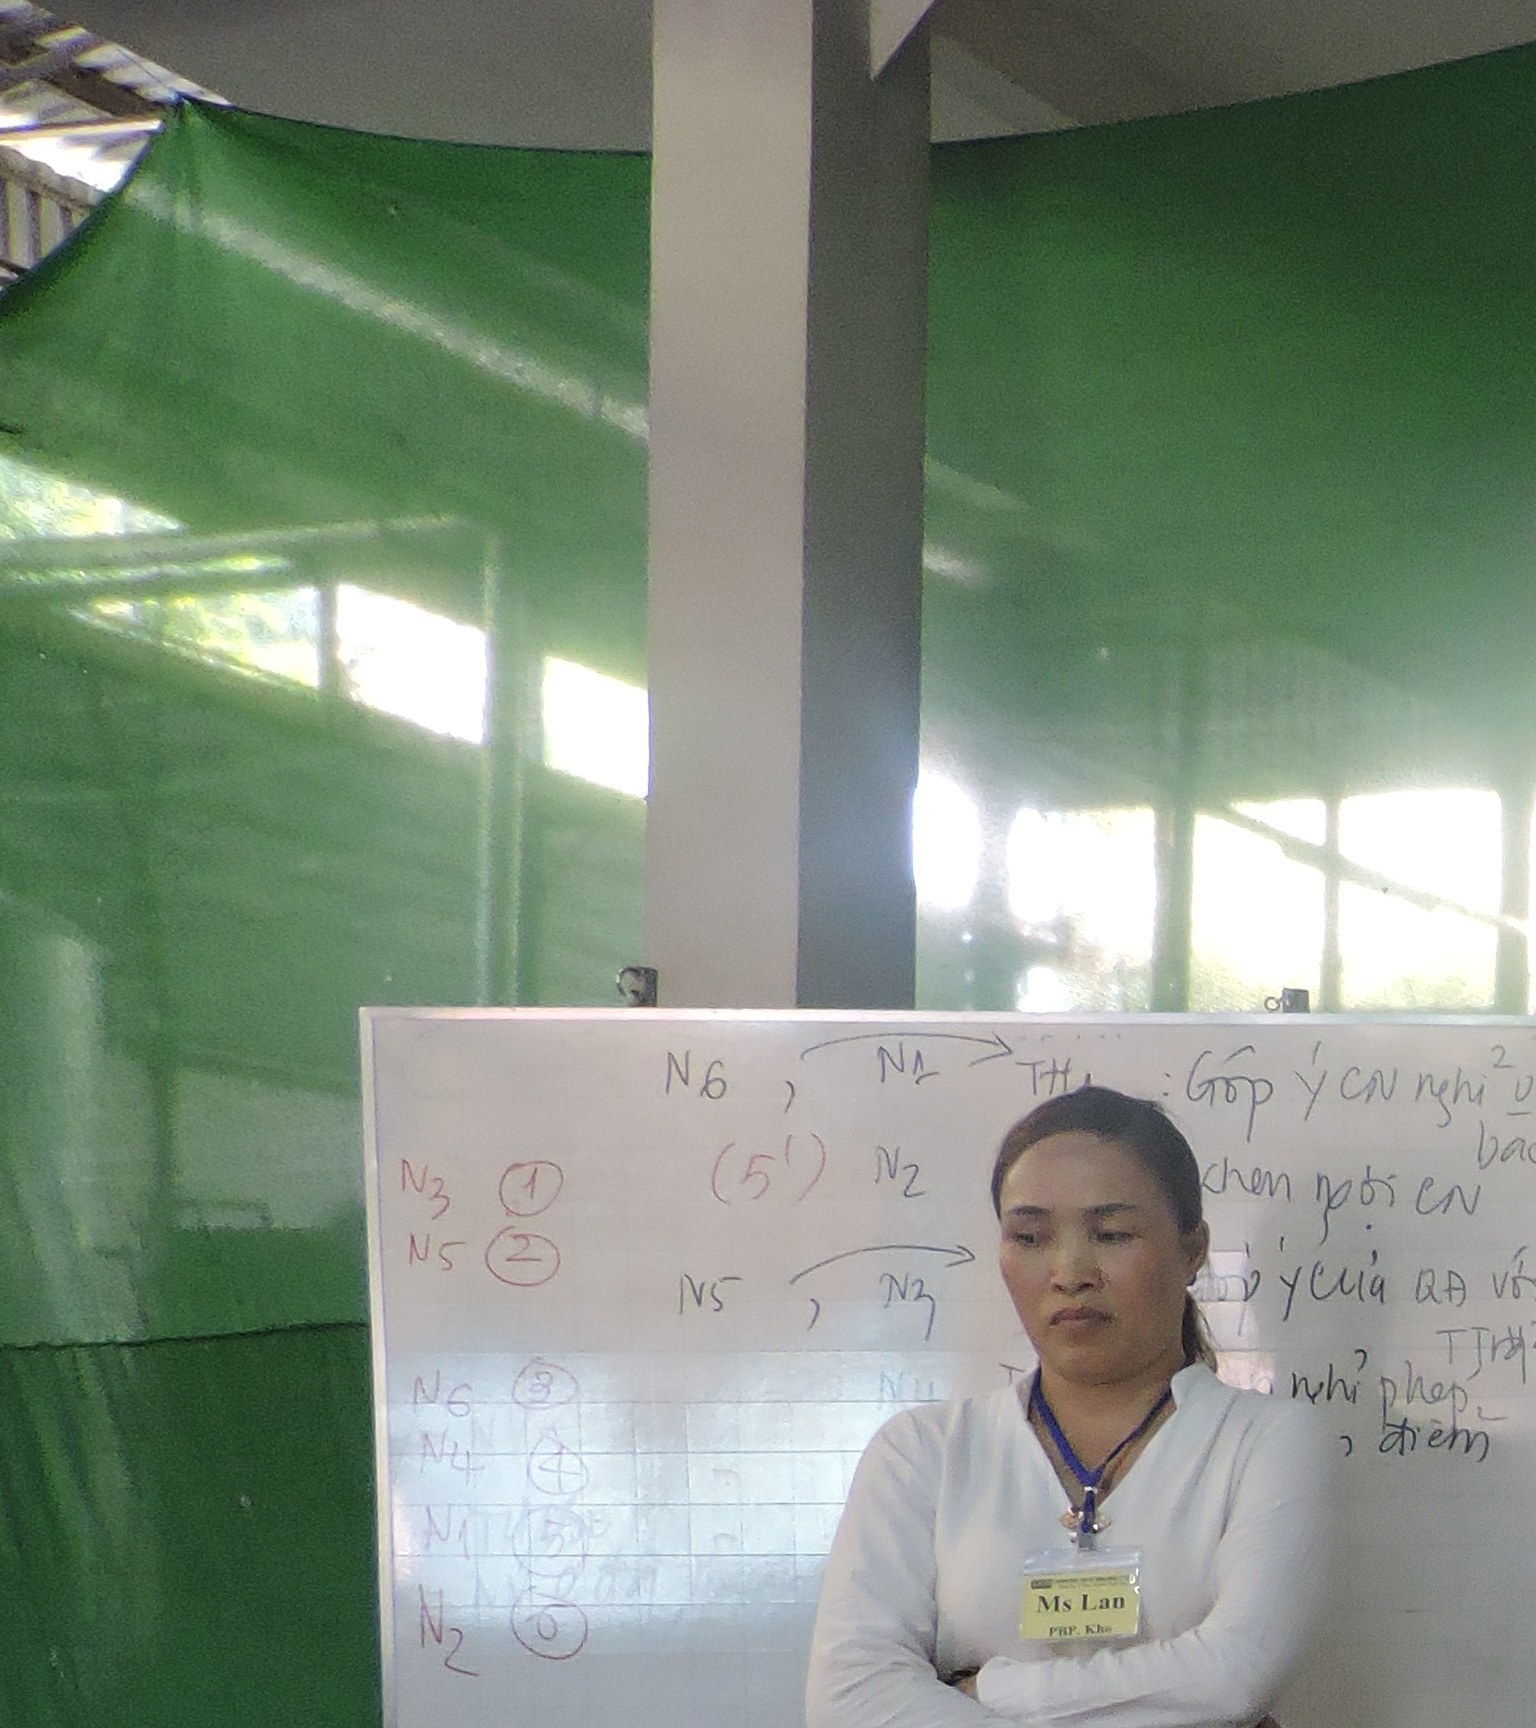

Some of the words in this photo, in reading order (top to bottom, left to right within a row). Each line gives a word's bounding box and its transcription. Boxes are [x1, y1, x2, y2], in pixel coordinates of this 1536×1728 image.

[874, 1145, 926, 1199] N2
[409, 1233, 467, 1272] N5
[1036, 1594, 1073, 1613] Ms
